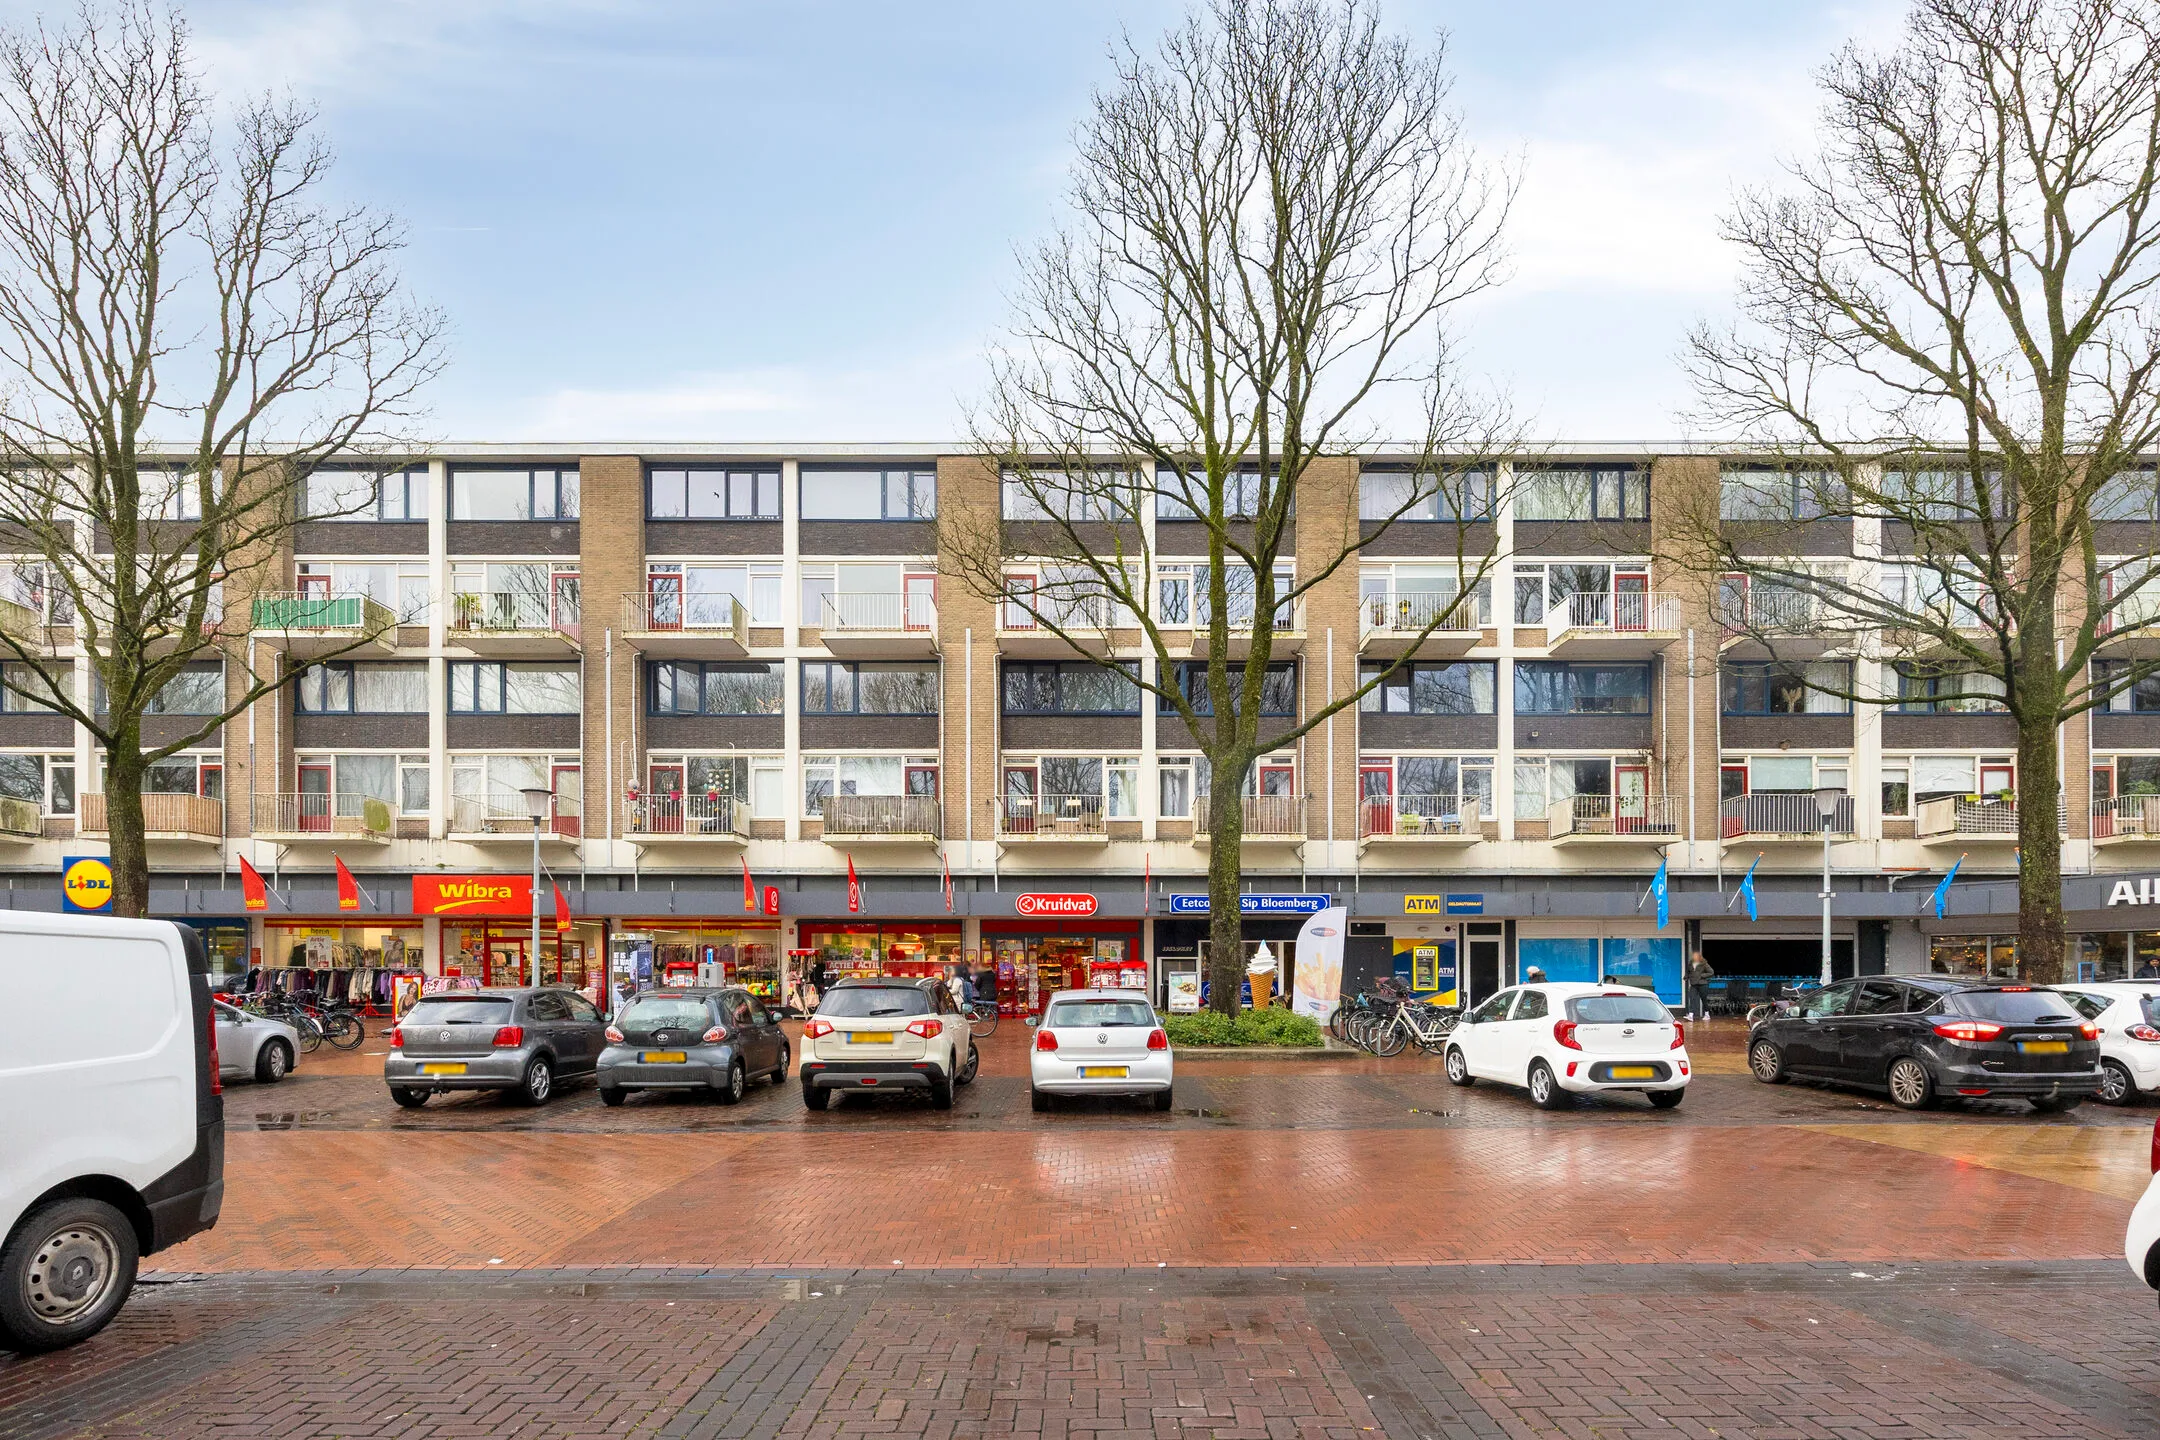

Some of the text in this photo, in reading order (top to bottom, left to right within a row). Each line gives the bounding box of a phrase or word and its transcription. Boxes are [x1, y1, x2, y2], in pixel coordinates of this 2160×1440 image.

[438, 879, 512, 898] Wibra
[1036, 897, 1093, 911] Kruidvat
[1182, 898, 1319, 910] Eetco Sip Bloemberg
[1406, 898, 1439, 910] ATM
